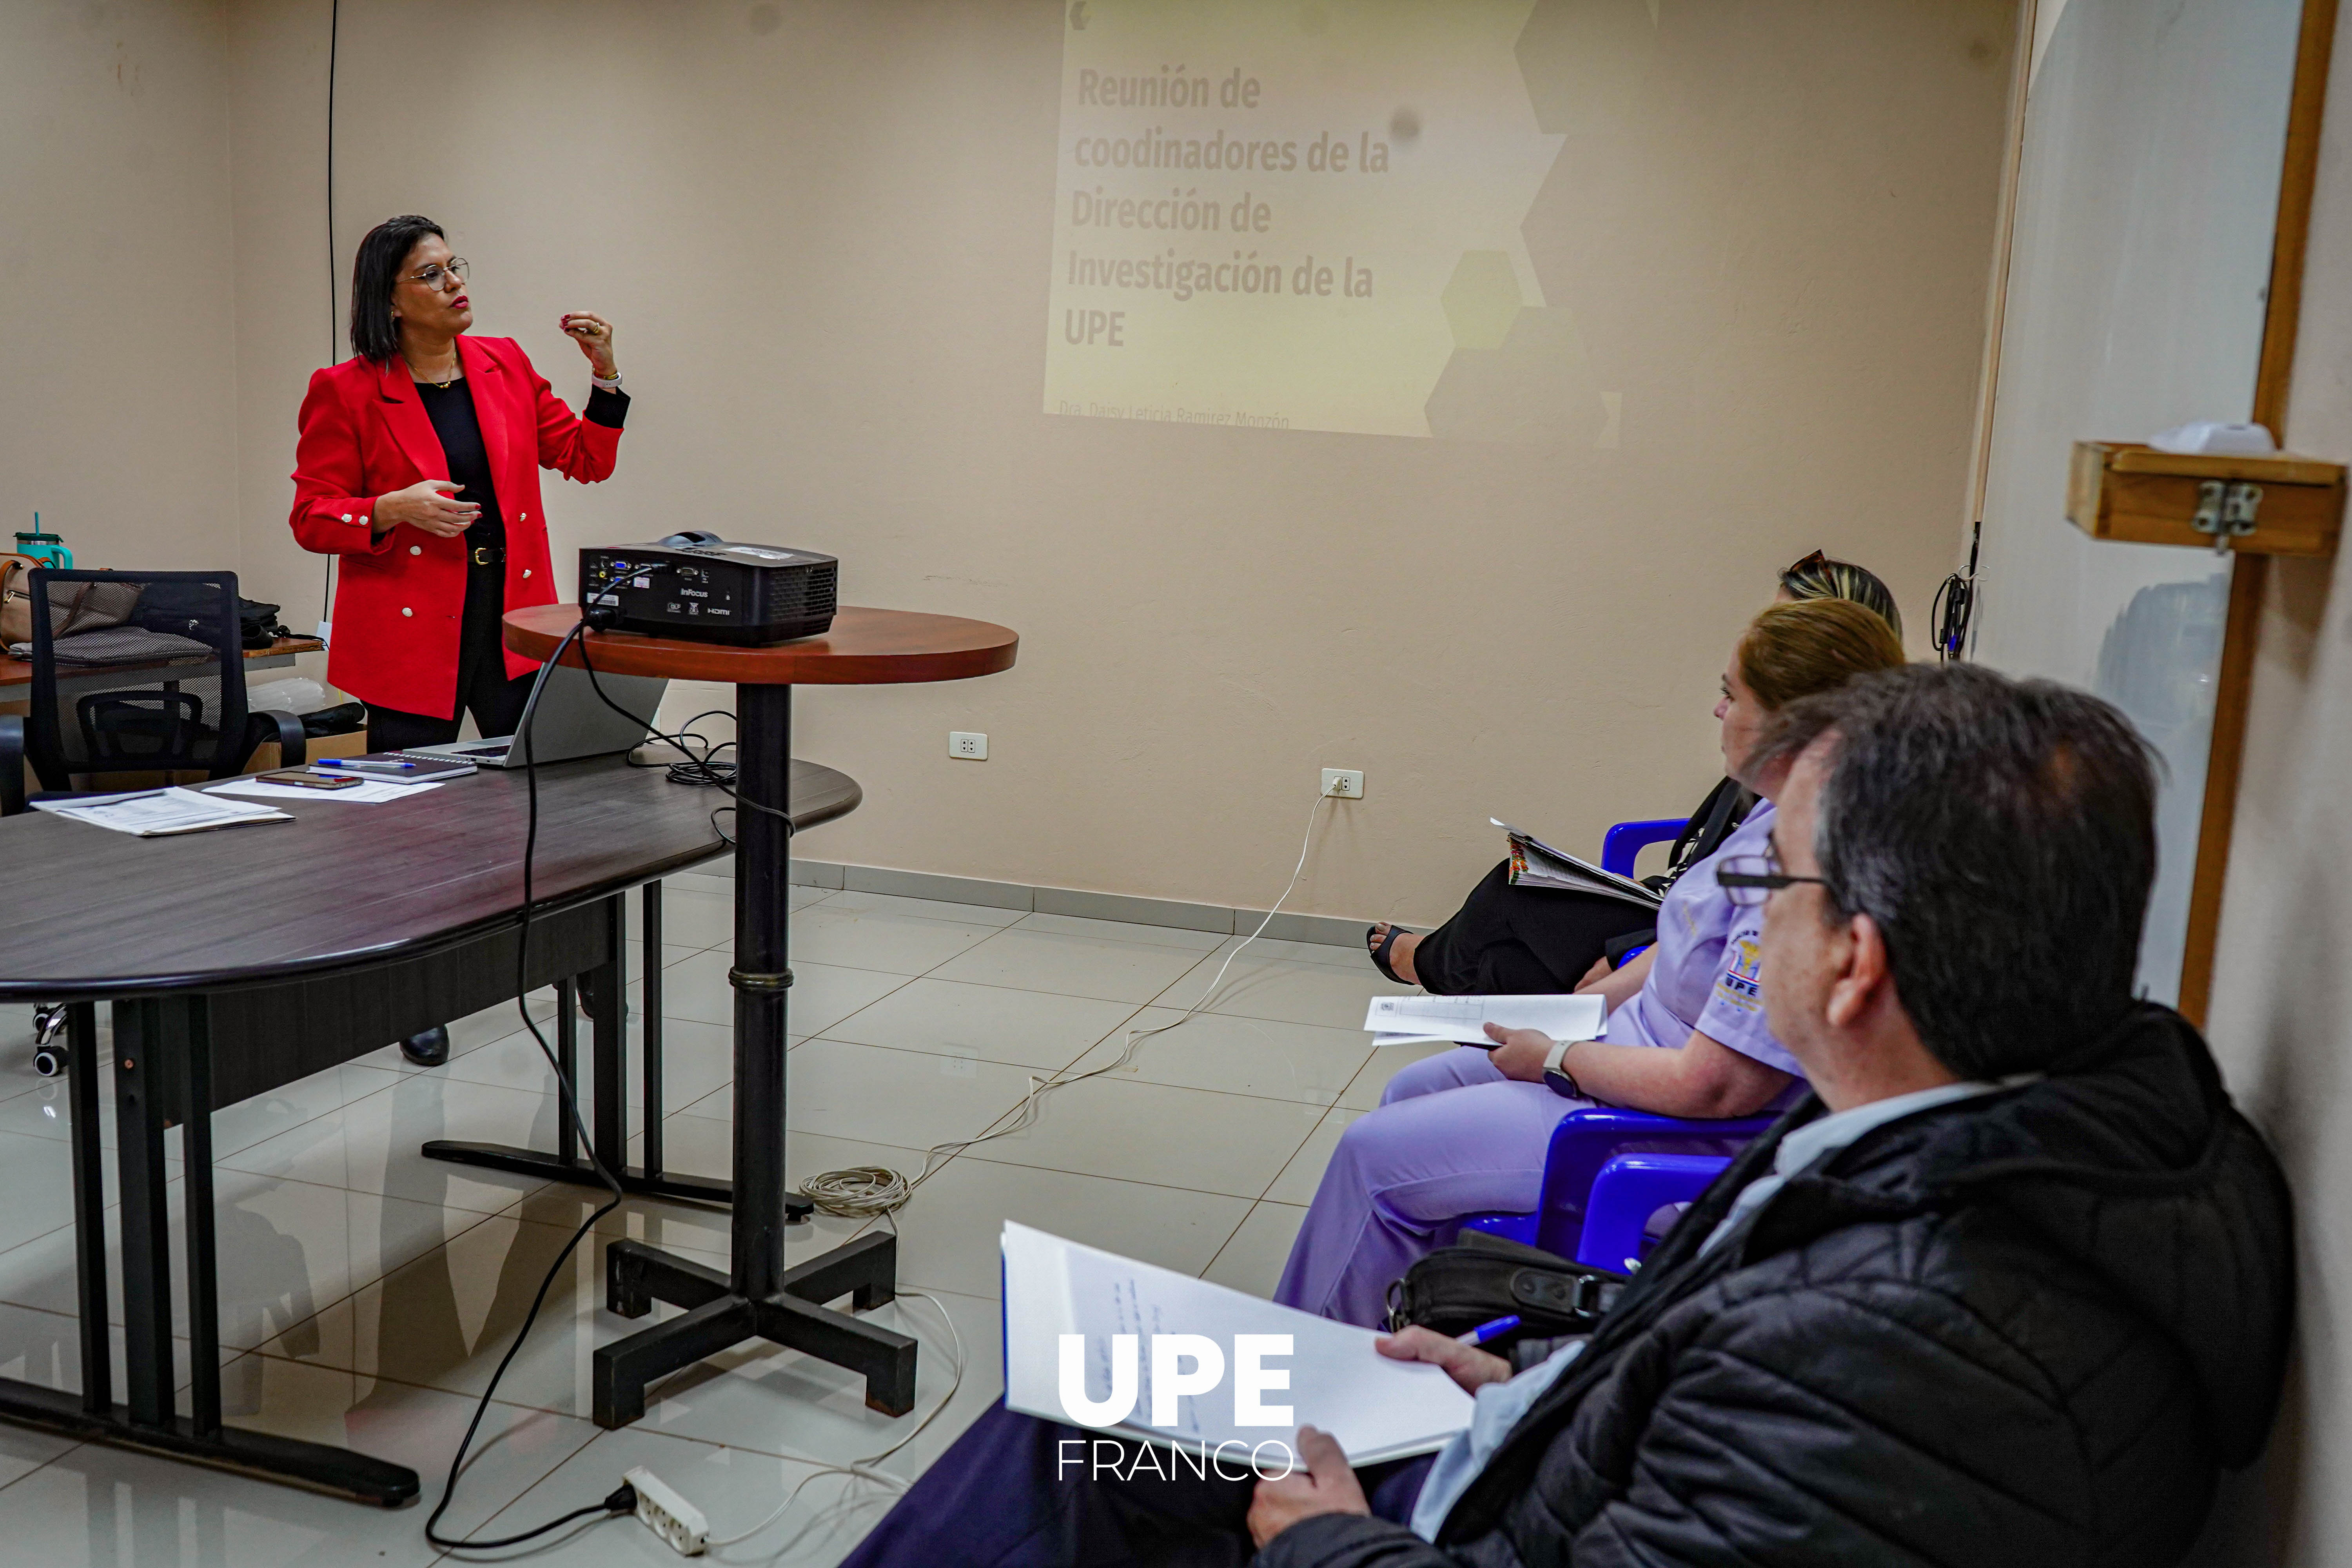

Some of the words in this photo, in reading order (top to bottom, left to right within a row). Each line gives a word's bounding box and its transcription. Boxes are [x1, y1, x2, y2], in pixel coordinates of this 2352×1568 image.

[1078, 64, 1209, 107] Reunión
[1220, 67, 1261, 109] de
[1074, 125, 1298, 172] coodinadores
[1306, 130, 1350, 172] de
[1359, 131, 1390, 173] la
[1071, 185, 1221, 231] Dirección
[1229, 191, 1272, 233] de
[1068, 247, 1283, 302] Investigación
[1292, 255, 1335, 297] de
[1343, 256, 1374, 299] la
[1064, 308, 1126, 348] UPE
[681, 588, 708, 597] InFocus
[1725, 977, 1757, 996] UPE
